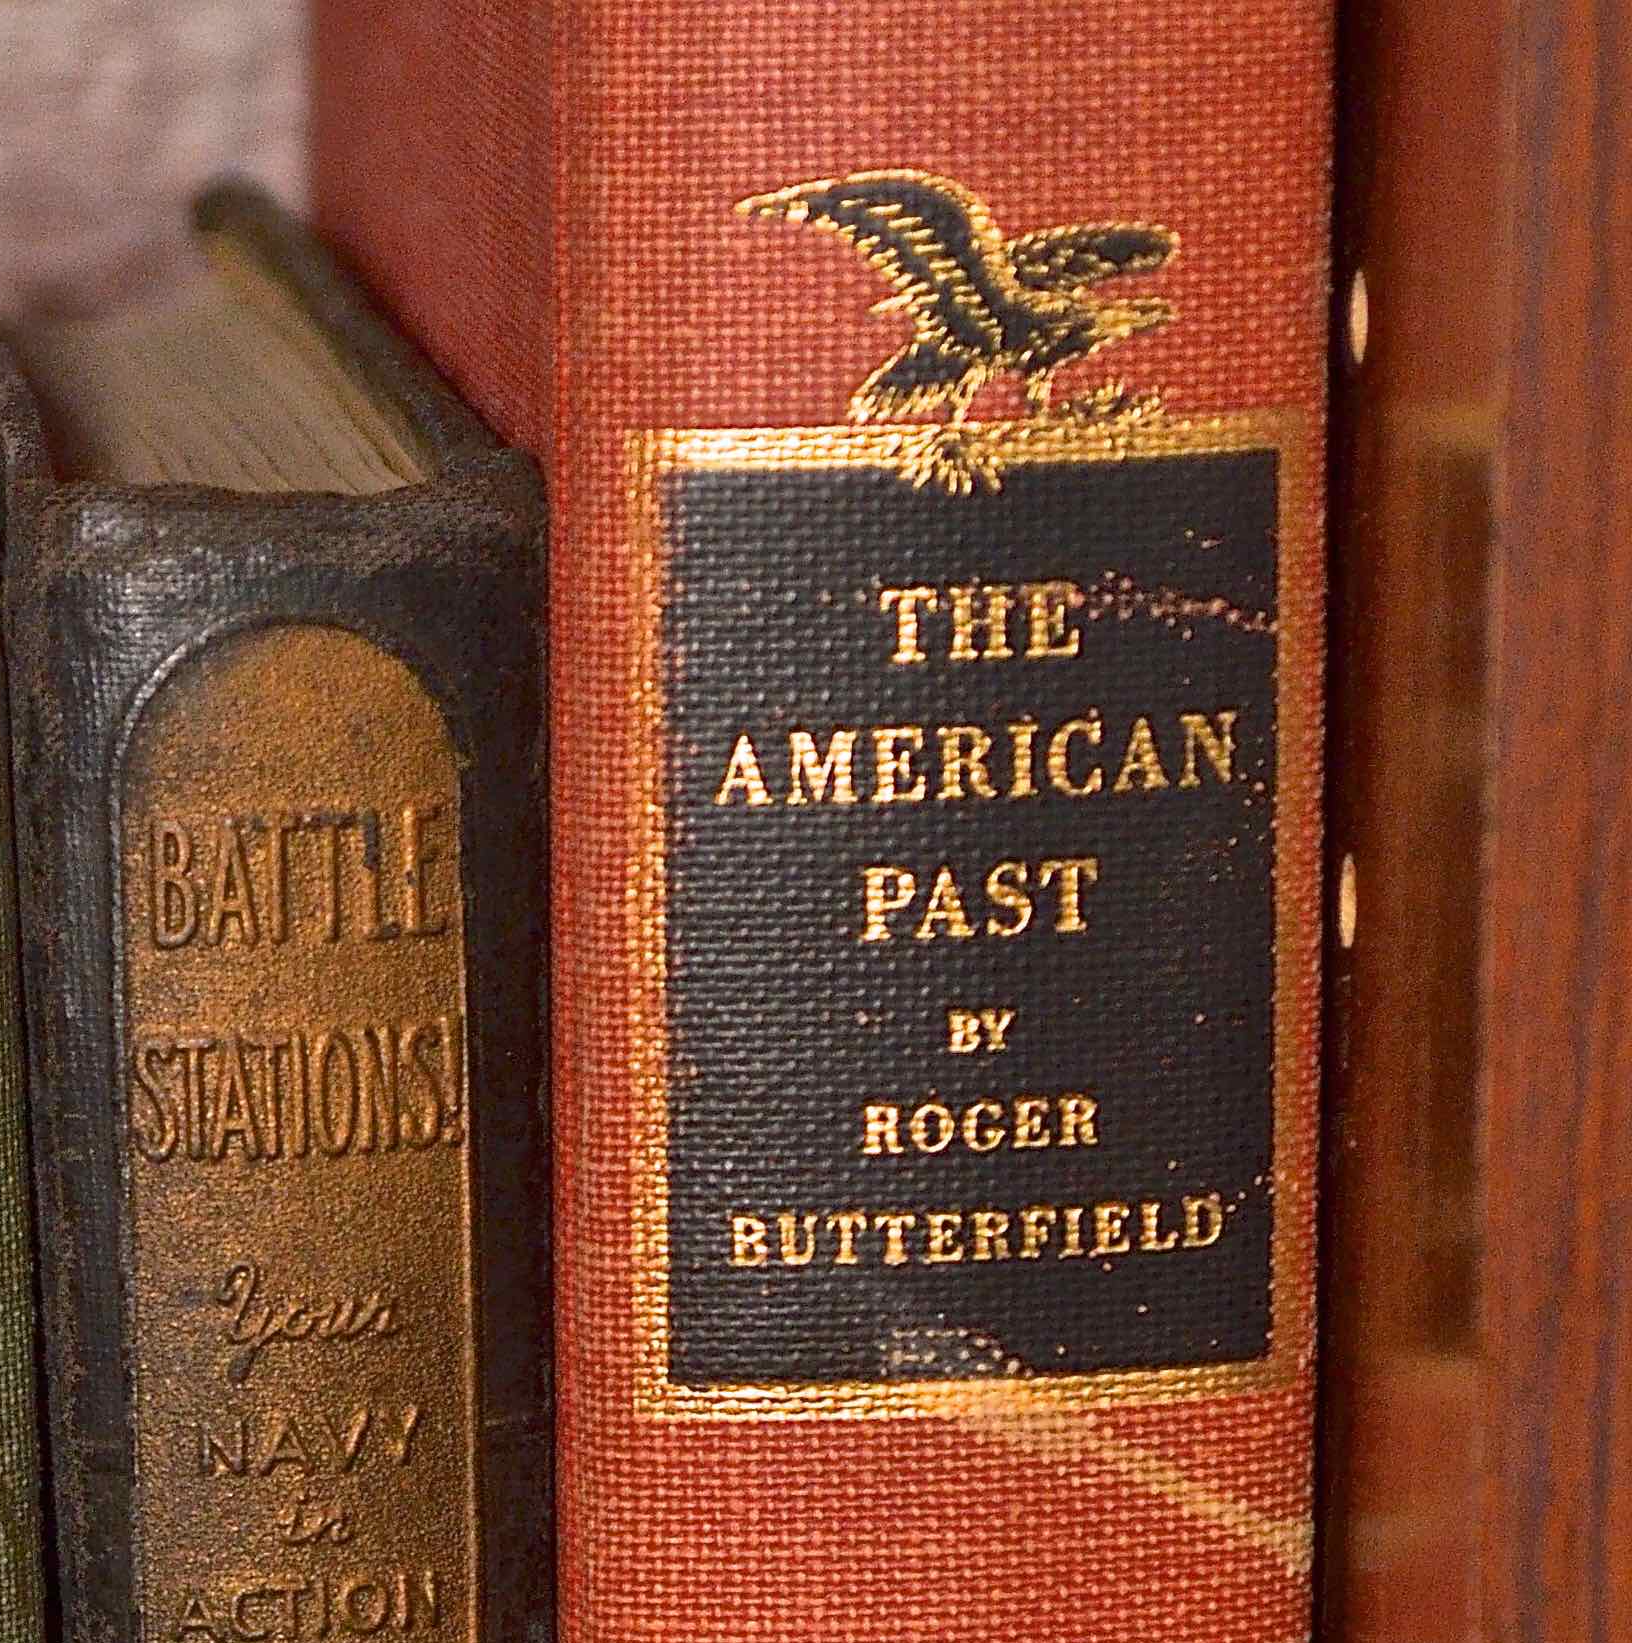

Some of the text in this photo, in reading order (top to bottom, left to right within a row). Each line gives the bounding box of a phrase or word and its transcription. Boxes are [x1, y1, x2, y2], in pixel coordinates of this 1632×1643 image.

[879, 580, 1084, 666] THE
[714, 712, 1238, 806] AMERICAN
[149, 803, 450, 951] BATTLE
[858, 857, 1099, 944] PAST
[946, 1007, 1016, 1055] BY
[134, 1016, 467, 1164] STATIONS!
[861, 1092, 1101, 1156] ROGER
[729, 1193, 1225, 1268] BUTTERFIELD
[216, 1262, 404, 1385] Your
[198, 1403, 420, 1478] NAVY
[175, 1570, 441, 1643] ACTION
